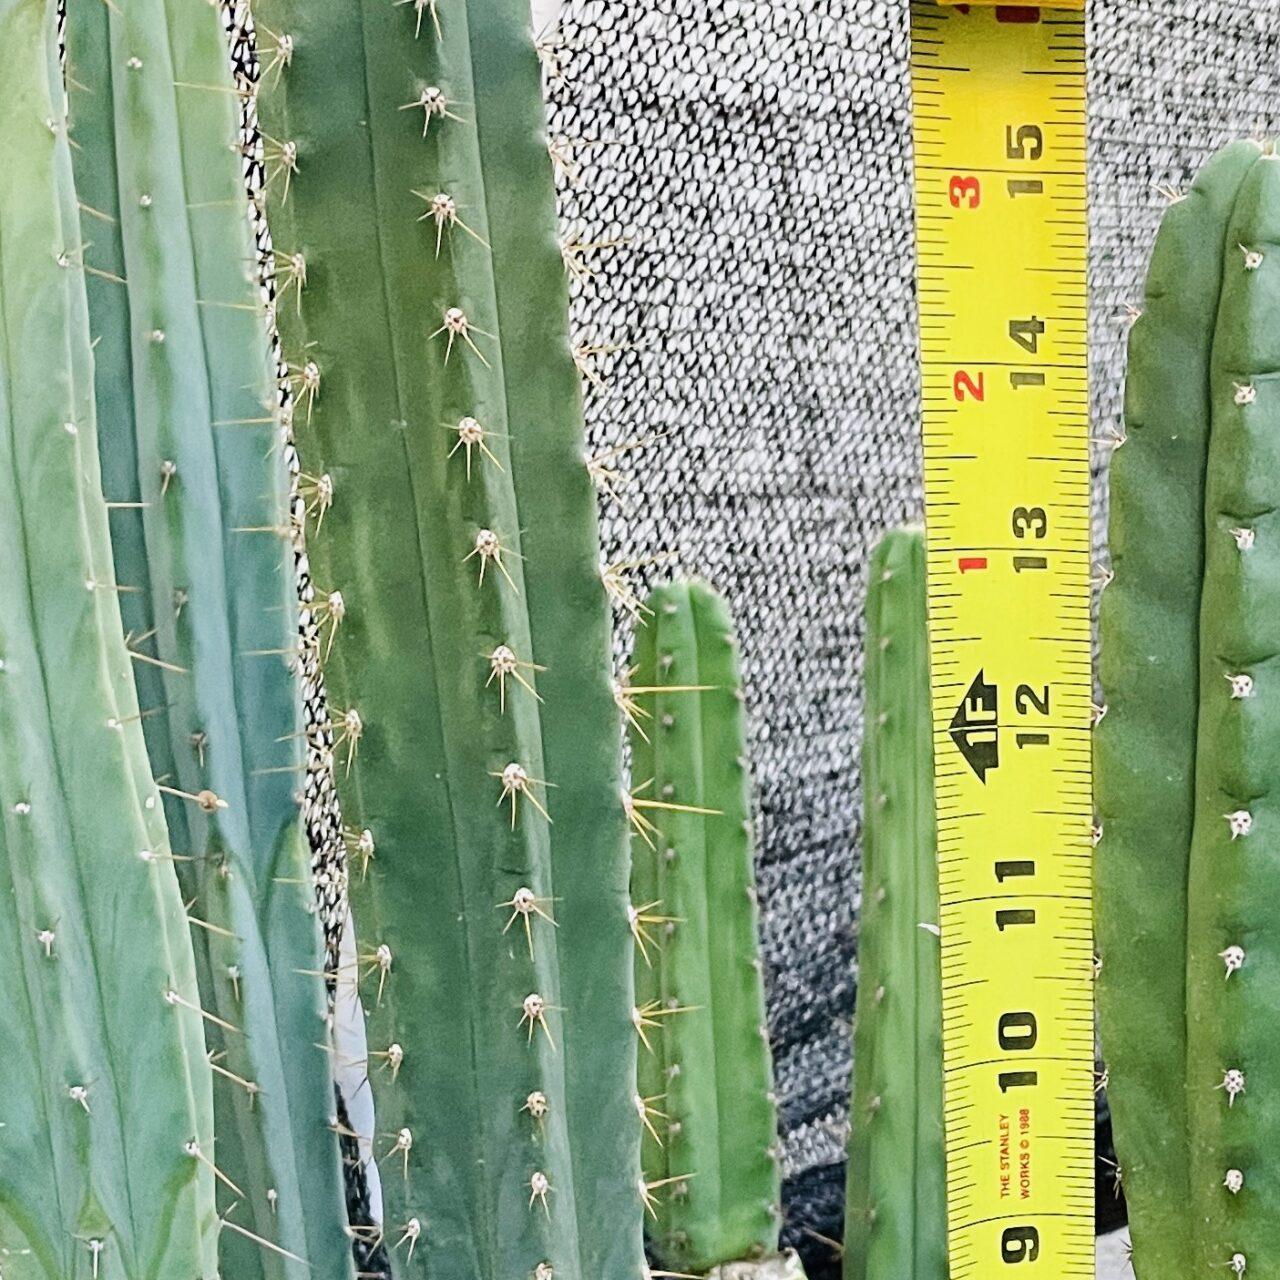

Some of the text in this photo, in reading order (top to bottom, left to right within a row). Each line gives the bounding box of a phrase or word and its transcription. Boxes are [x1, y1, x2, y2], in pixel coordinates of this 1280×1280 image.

[949, 175, 980, 209] 3
[953, 370, 984, 402] 2
[958, 557, 987, 574] 1
[1019, 1108, 1030, 1135] 1988
[999, 1114, 1011, 1199] THE STANLEY
[1019, 1153, 1030, 1199] WORKS
[1002, 1226, 1039, 1263] 9
